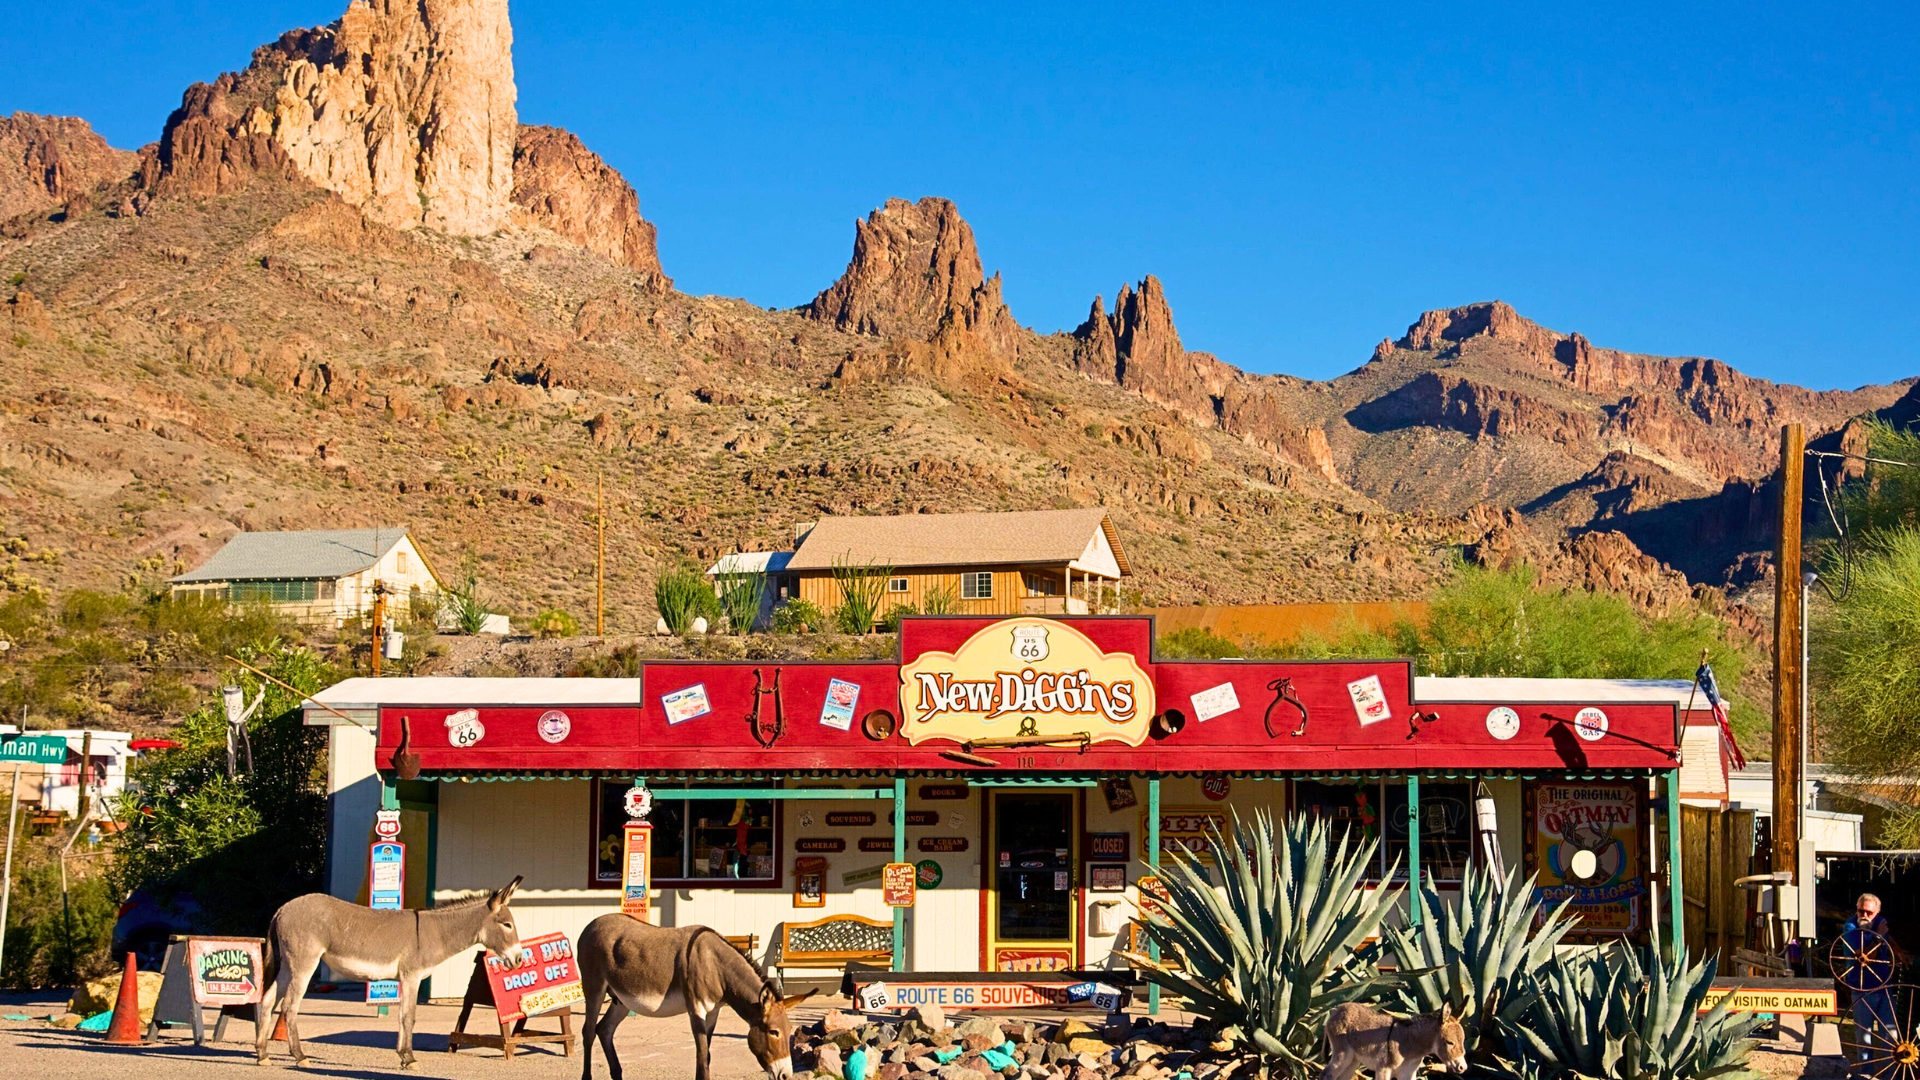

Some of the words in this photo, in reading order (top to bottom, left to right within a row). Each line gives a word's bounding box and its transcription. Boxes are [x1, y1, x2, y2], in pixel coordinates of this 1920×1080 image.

[1020, 645, 1039, 657] 66
[915, 672, 995, 722] New
[459, 728, 477, 744] 66
[0, 738, 37, 756] man
[42, 744, 65, 760] Hwy
[1017, 757, 1034, 768] 110
[1205, 780, 1229, 796] GULF
[1546, 787, 1569, 803] THE
[1573, 789, 1623, 800] ORIGINAL
[802, 819, 813, 827] 66
[1544, 805, 1631, 834] OATMAN
[380, 822, 396, 832] 66
[1093, 838, 1124, 853] CLOSED
[886, 866, 911, 877] PLEASE
[1142, 880, 1163, 890] PLEAS
[1552, 904, 1600, 913] DCOVERED
[1603, 905, 1626, 914] 1986
[487, 948, 537, 974] TR
[540, 939, 573, 963] BUS
[197, 950, 249, 982] PARKING
[503, 971, 538, 991] DROP
[544, 963, 569, 981] OFF
[221, 984, 240, 992] BACK
[526, 996, 540, 1010] BUS
[539, 992, 548, 1000] AND
[562, 994, 570, 1003] IN
[572, 991, 585, 1001] BAC
[870, 995, 887, 1009] 66
[897, 988, 947, 1004] ROUTE
[953, 988, 974, 1004] 66
[981, 987, 1068, 1004] SOUVENIRS
[1095, 996, 1112, 1009] 66
[1733, 996, 1779, 1007] VISITING
[1784, 997, 1828, 1008] OATMAN
[542, 998, 555, 1009] CAR
